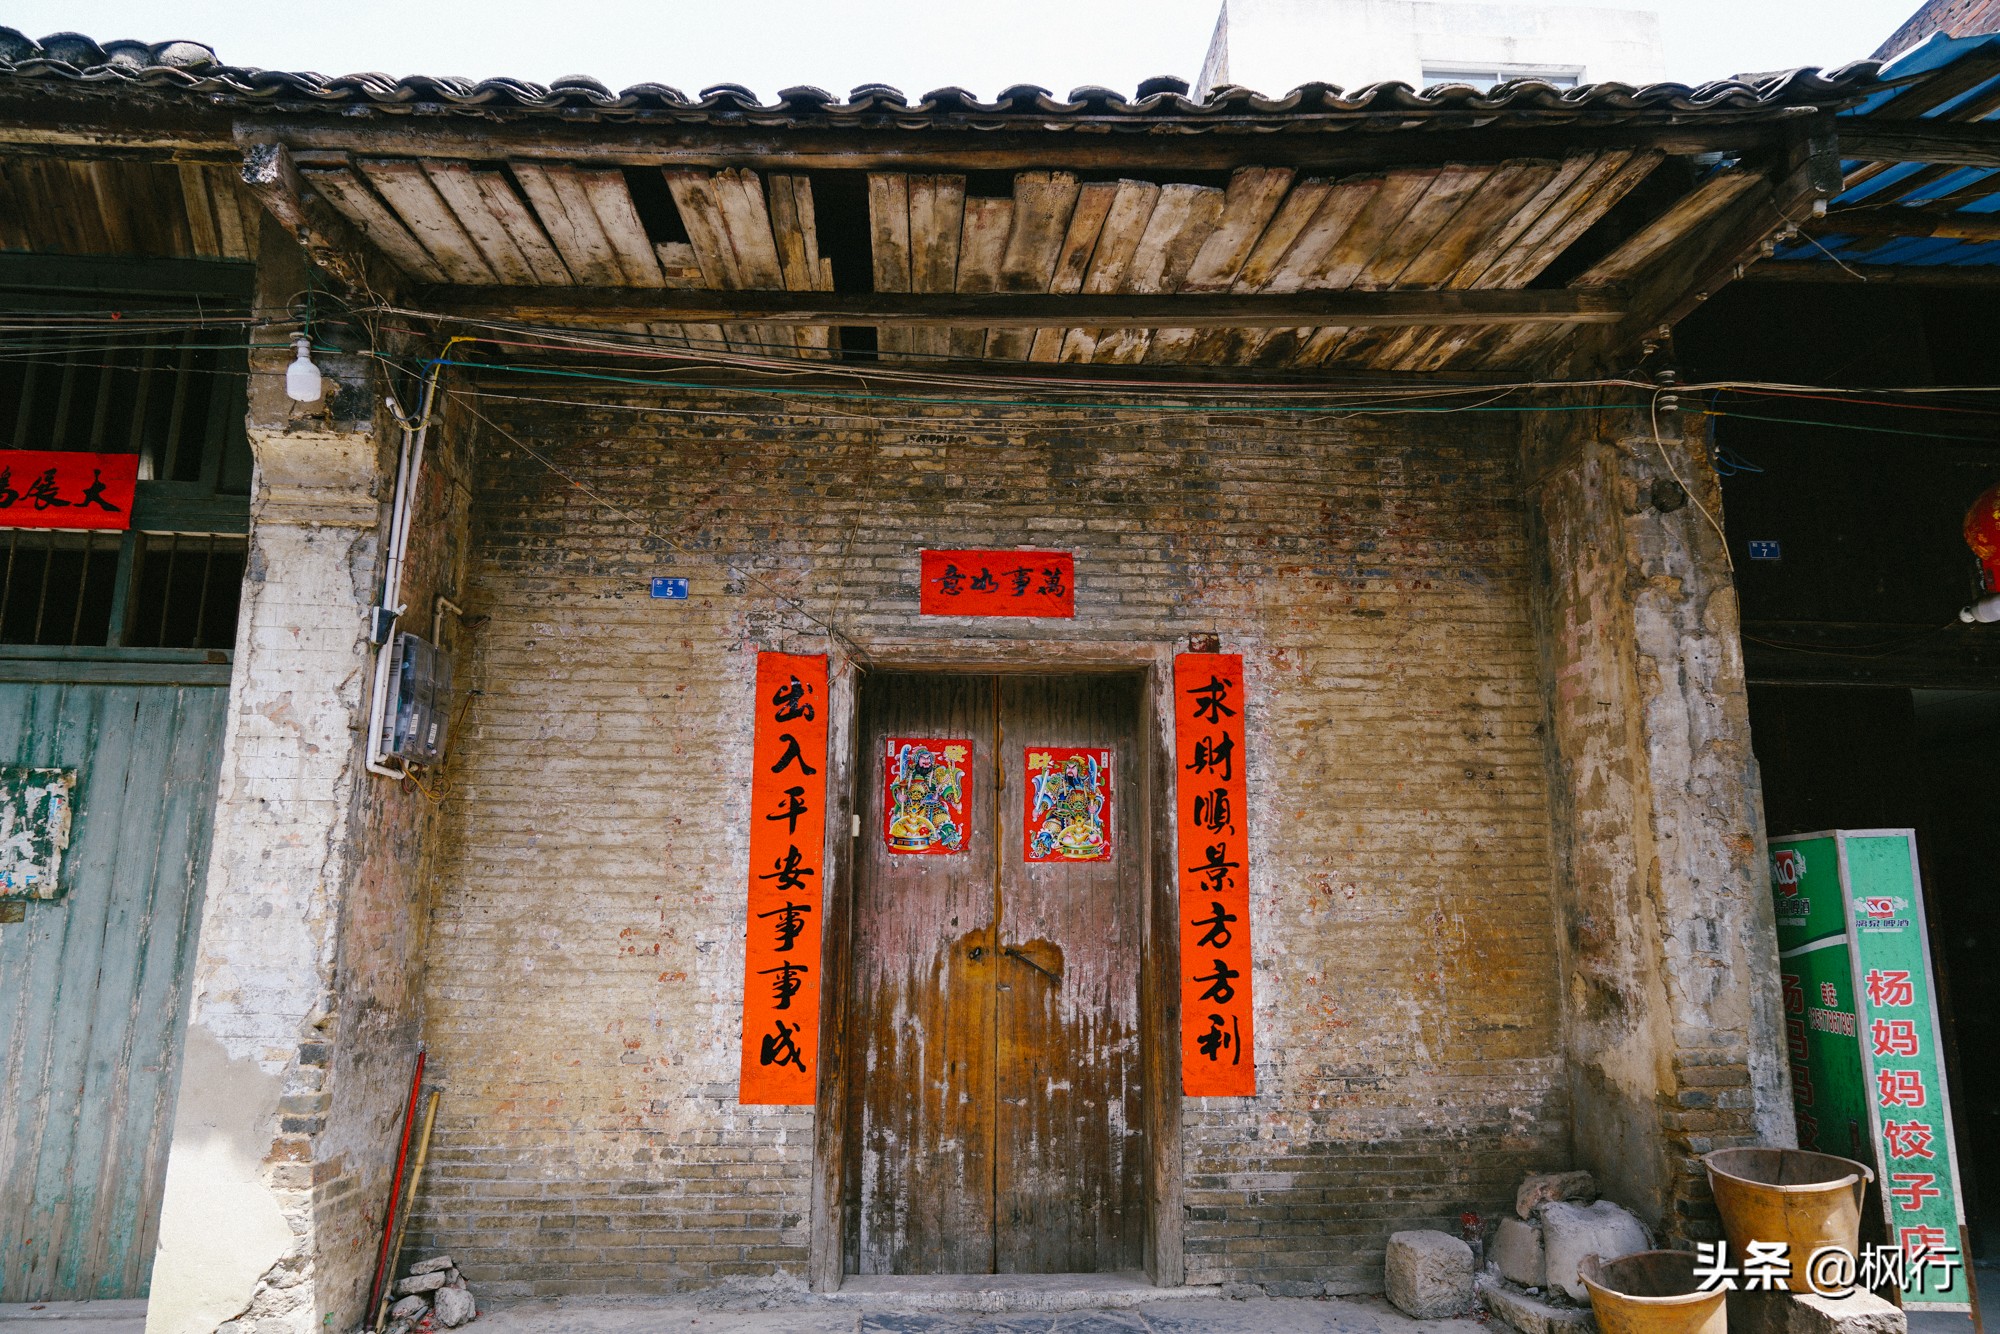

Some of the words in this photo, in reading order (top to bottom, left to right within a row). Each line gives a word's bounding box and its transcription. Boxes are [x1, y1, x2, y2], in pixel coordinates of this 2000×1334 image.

[666, 587, 674, 596] 5
[757, 675, 817, 1073] 出入平安事事成
[1185, 675, 1240, 1067] 求財順景方方利
[1865, 970, 1946, 1264] 杨妈妈饺子店
